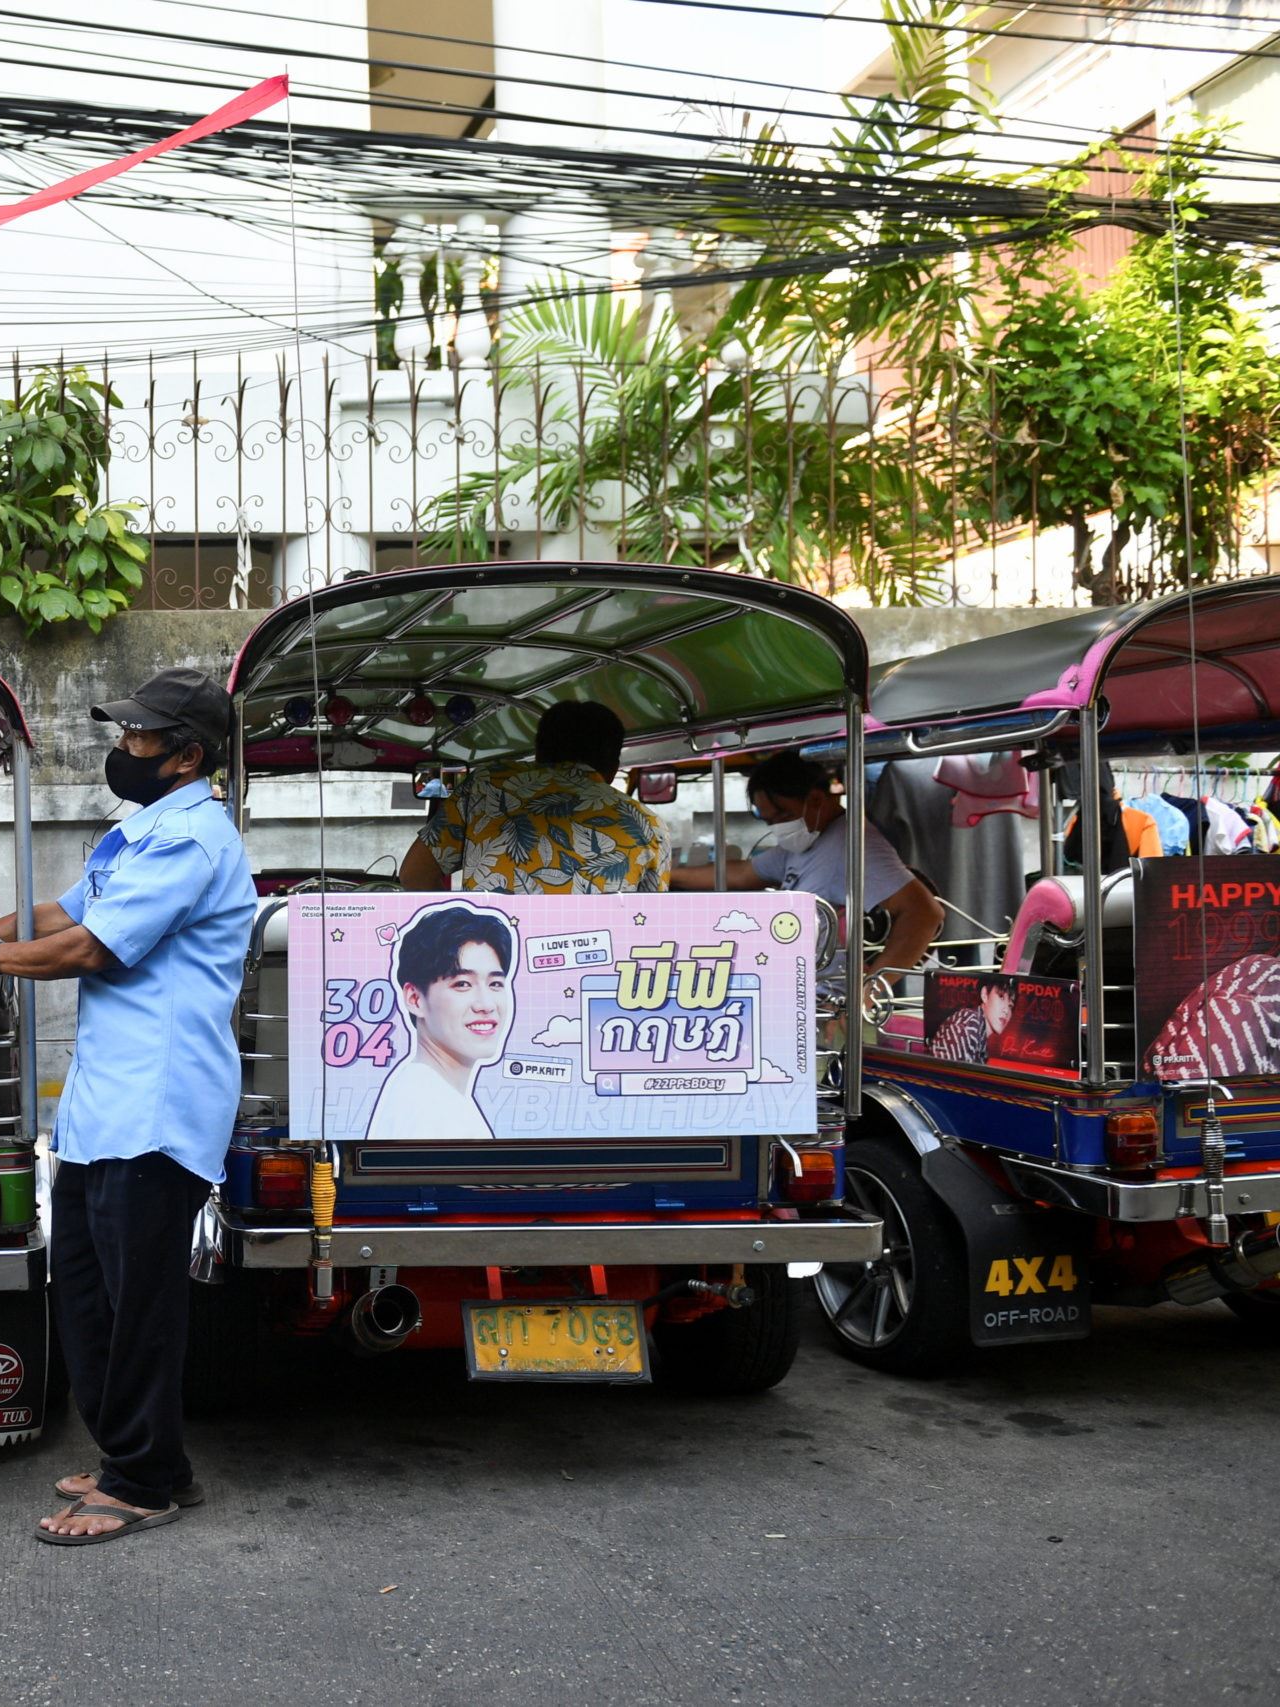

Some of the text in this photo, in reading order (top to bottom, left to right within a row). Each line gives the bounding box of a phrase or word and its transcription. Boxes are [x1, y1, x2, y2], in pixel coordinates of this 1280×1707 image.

[547, 940, 569, 950] LOVE
[572, 938, 590, 948] YOU
[539, 957, 560, 966] YES
[615, 940, 737, 1011] พีพี
[939, 975, 979, 989] HAPPY
[320, 978, 397, 1024] 30
[321, 1020, 397, 1068] 04
[525, 1065, 566, 1077] PP.KRITT
[644, 1077, 726, 1091] #22PPsBDay
[984, 1306, 1080, 1328] OFF-ROAD
[2, 1410, 27, 1423] TUK
